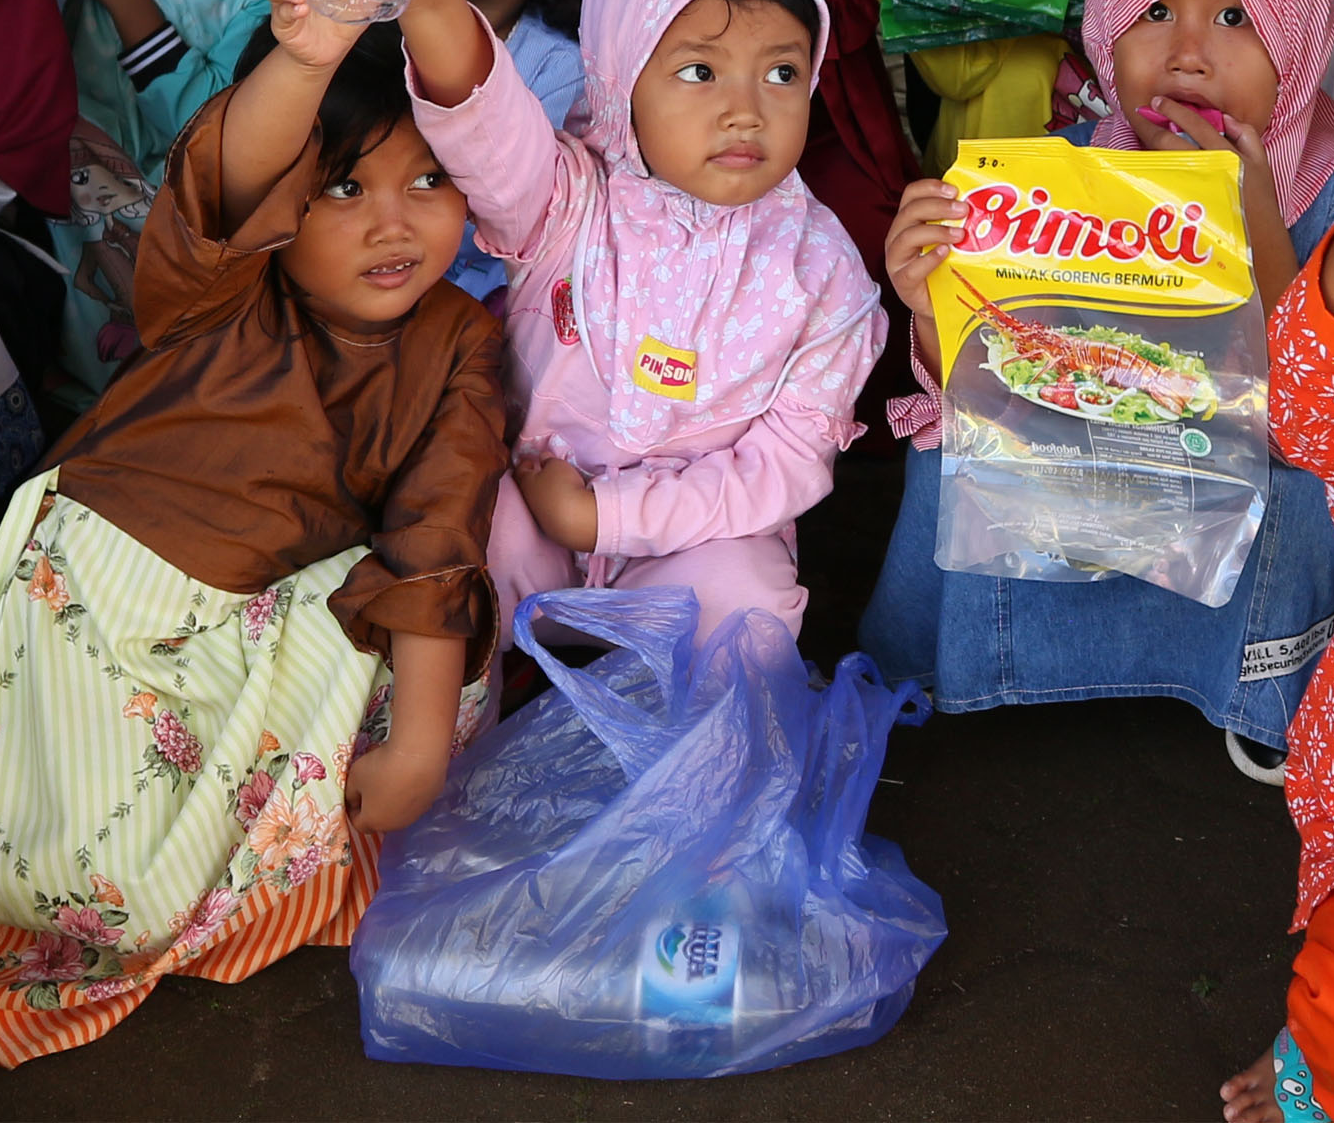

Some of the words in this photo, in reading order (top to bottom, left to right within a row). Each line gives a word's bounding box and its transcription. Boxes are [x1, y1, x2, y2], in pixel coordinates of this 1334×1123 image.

[951, 184, 1212, 266] Bimoli
[996, 267, 1048, 282] MINYAK
[1051, 270, 1110, 285] GORENG
[1114, 274, 1184, 288] BERMUTU
[640, 354, 694, 383] PINSON
